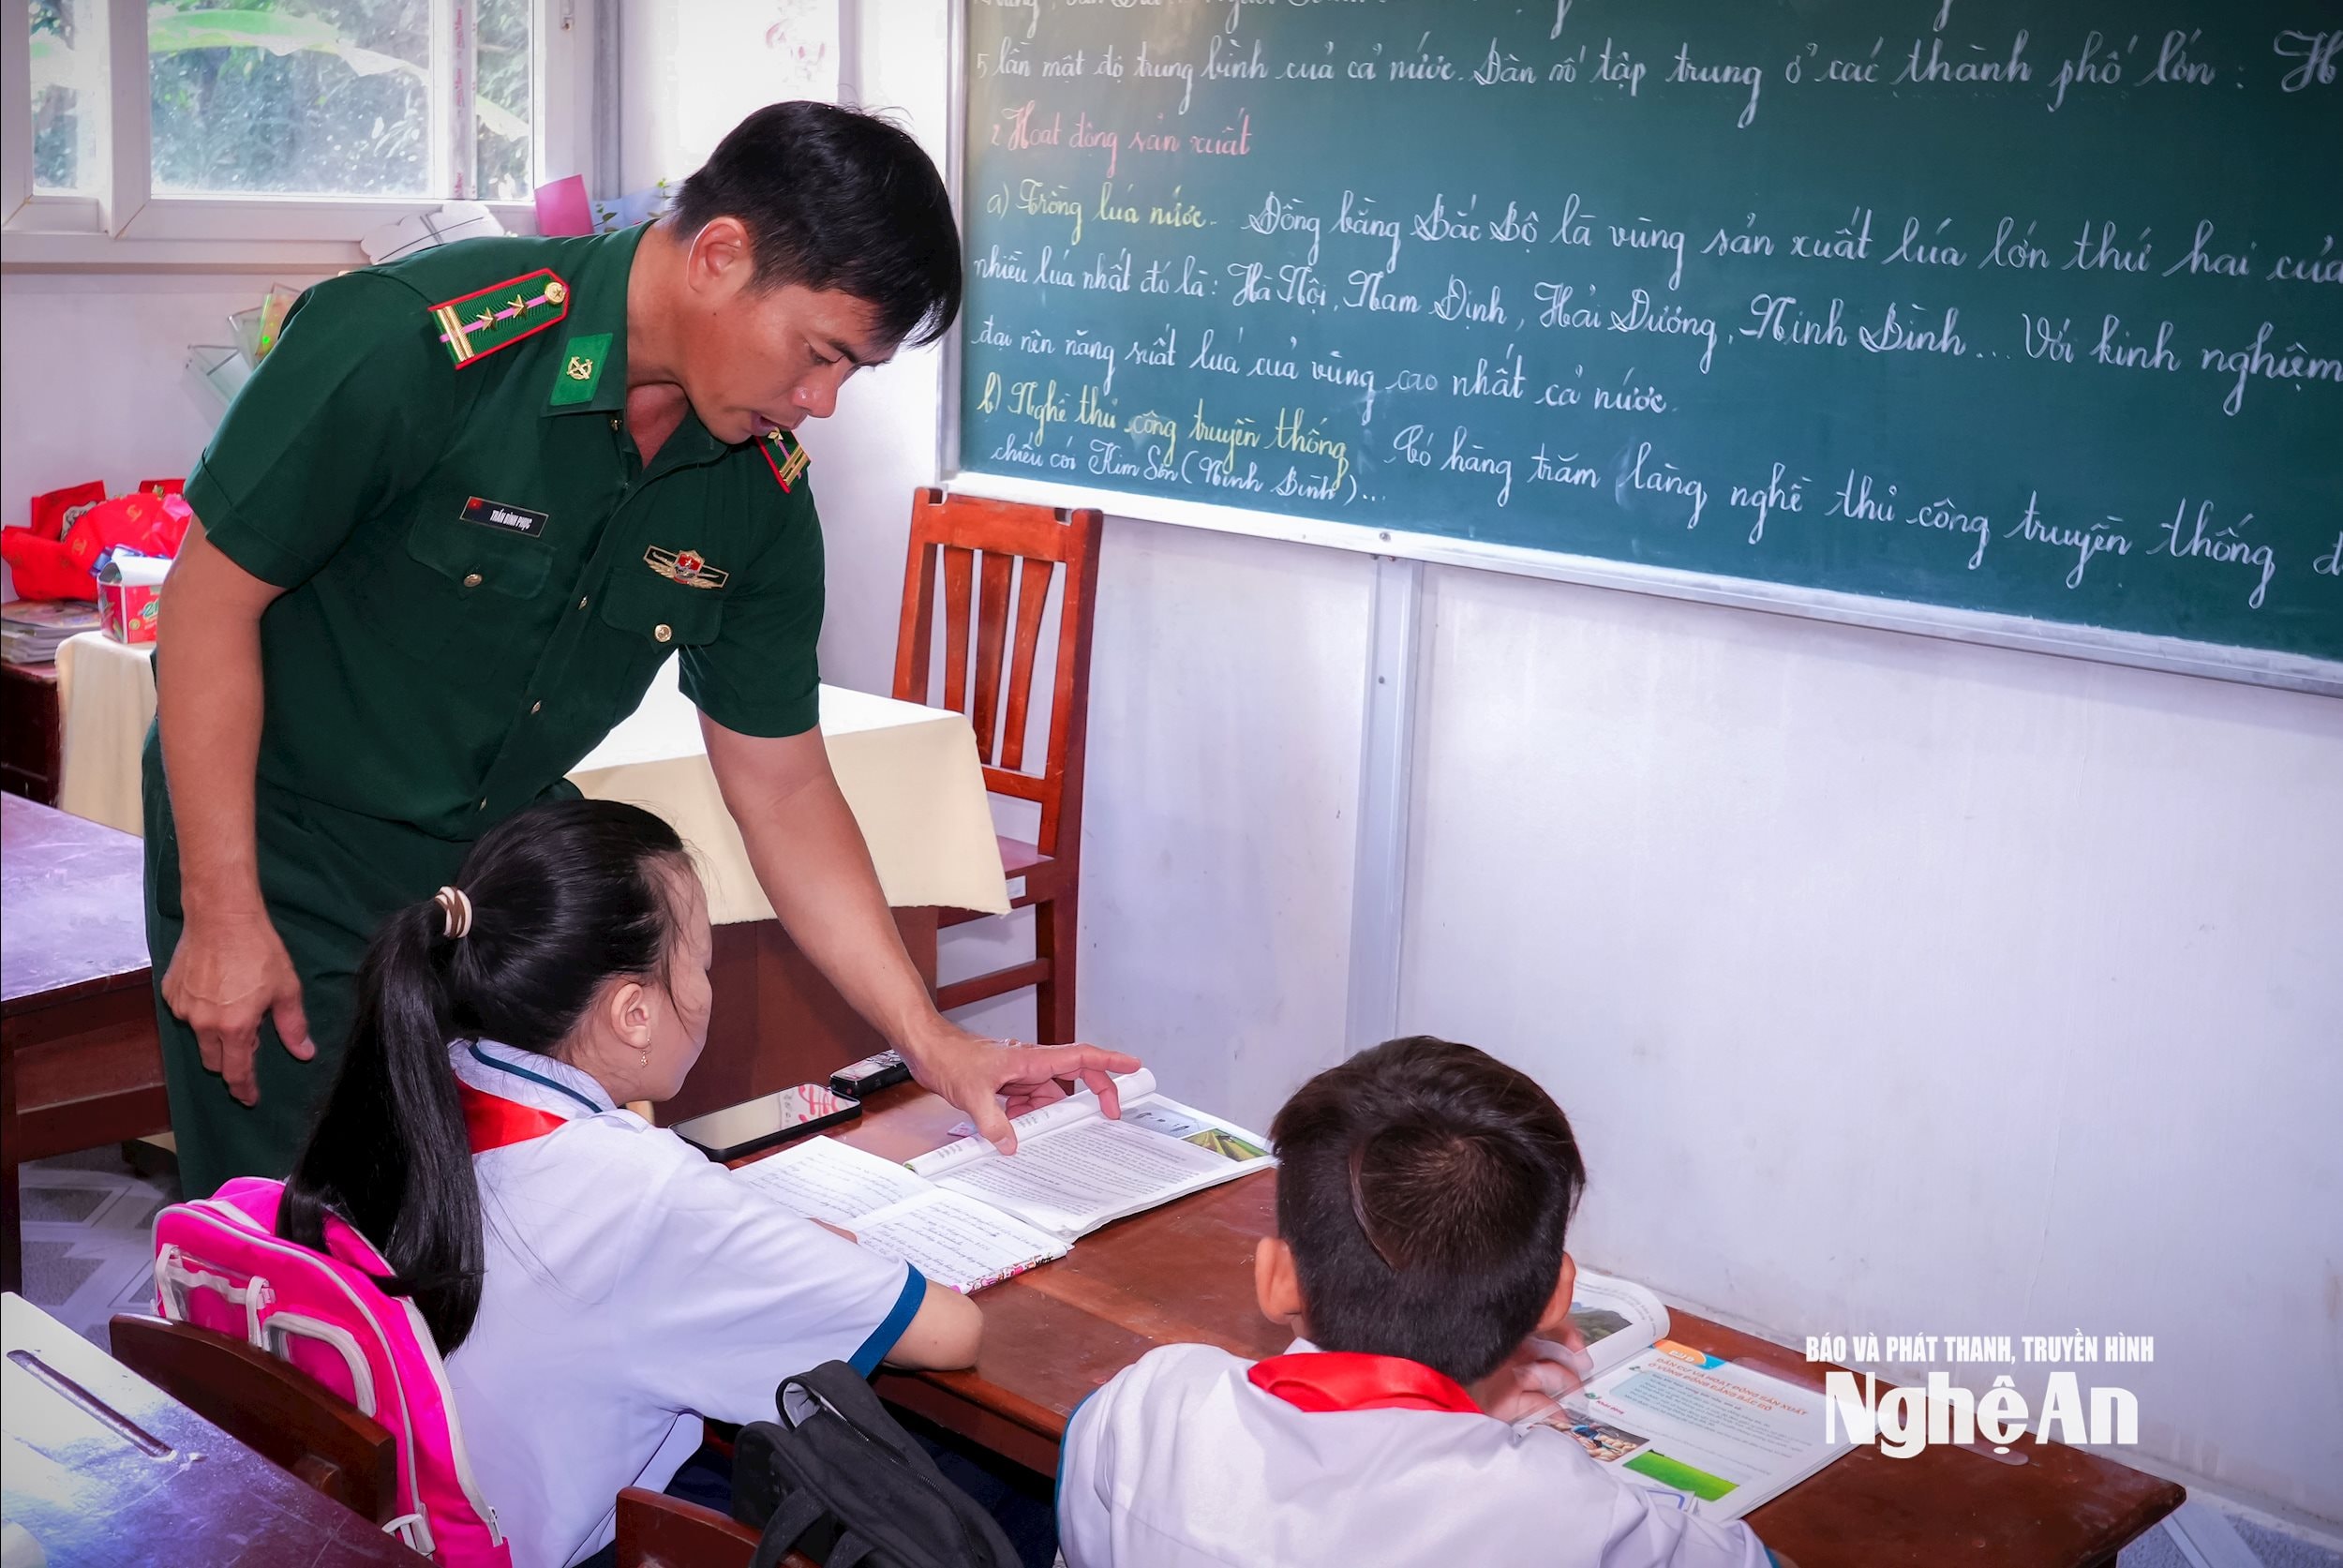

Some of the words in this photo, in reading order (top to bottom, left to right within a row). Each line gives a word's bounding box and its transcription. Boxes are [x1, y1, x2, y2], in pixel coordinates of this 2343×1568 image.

[1042, 50, 1083, 83] mật
[1095, 43, 1124, 83] độ
[1134, 42, 1193, 114] trung
[1201, 35, 1269, 82] bình
[1276, 40, 1336, 82] của
[1348, 42, 1382, 80] cả
[1548, 45, 1586, 83] số
[1590, 37, 1647, 96] tập
[1665, 41, 1763, 128] trung
[1814, 37, 1884, 82] các
[1889, 28, 2033, 85] thành
[2047, 30, 2140, 112] phố
[1127, 112, 1180, 152] sản
[1189, 108, 1252, 156] xuất
[1092, 182, 1140, 223] lúa
[1410, 193, 1482, 242] Bắc
[1489, 201, 1540, 253] Bộ
[1549, 193, 1596, 246] là
[1607, 217, 1687, 291] vùng
[1701, 212, 1775, 256] sản
[1789, 205, 1873, 261] xuất
[1881, 216, 1967, 266] lúa
[1978, 216, 2051, 270] lớn
[2062, 218, 2153, 273] thứ
[2162, 218, 2257, 277] hai
[973, 245, 1028, 284] nhiều
[1034, 246, 1075, 287] lúa
[1082, 248, 1131, 292] nhất
[1140, 260, 1172, 295] đó
[1227, 261, 1273, 307] Hà
[1343, 268, 1422, 314] Nam
[1533, 281, 1602, 329] Hải
[1739, 293, 1849, 347] Ninh
[2022, 312, 2075, 364] Với
[2089, 313, 2182, 372] kinh
[2201, 321, 2343, 417] nghiệm
[1020, 328, 1055, 353] nên
[1065, 328, 1115, 396] năng
[1124, 323, 1177, 368] suất
[1188, 325, 1244, 375] lúa
[1247, 336, 1299, 381] của
[1311, 350, 1376, 426] vùng
[1385, 368, 1439, 392] cao
[1452, 343, 1527, 399] nhất
[1534, 364, 1584, 407] cả
[1007, 379, 1071, 448] Nghề
[1074, 383, 1119, 429] thủ
[1124, 410, 1177, 468] công
[1188, 397, 1261, 475] truyền
[1263, 407, 1350, 492] thống
[1440, 426, 1513, 508] hàng
[1527, 441, 1601, 489] trăm
[1619, 441, 1708, 530] làng
[1730, 462, 1812, 545] nghề
[1825, 469, 1898, 522] thủ
[1906, 498, 1990, 571] công
[2004, 489, 2132, 590] truyền
[2146, 497, 2276, 609] thống
[1088, 439, 1140, 477] Kim
